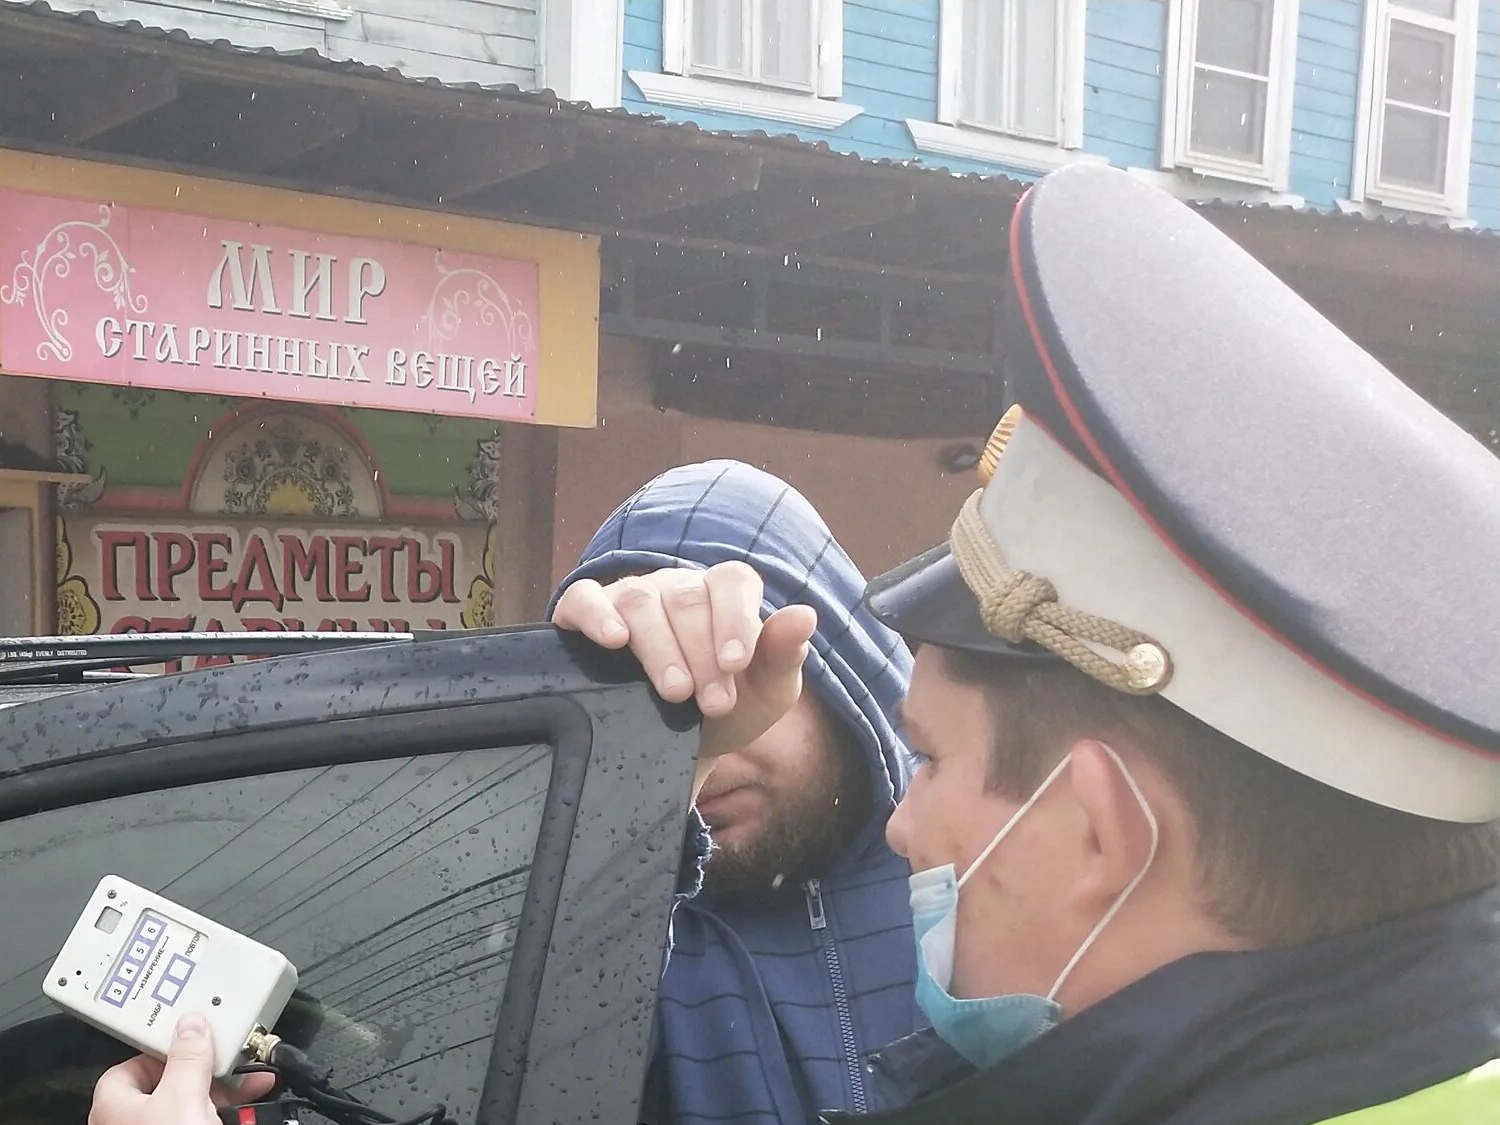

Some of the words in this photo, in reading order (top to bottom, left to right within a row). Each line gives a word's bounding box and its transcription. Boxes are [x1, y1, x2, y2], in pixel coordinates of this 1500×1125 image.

[207, 238, 386, 325] МИР
[94, 314, 371, 384] СТАРИННЫХ
[384, 346, 528, 402] ВЕЩЕЙ
[96, 528, 461, 612] ПРЕДМЕТЫ
[113, 988, 122, 996] 3
[125, 967, 133, 975] 4
[140, 948, 165, 989] ИЗМЕРЕНИЕ
[146, 1003, 162, 1027] КАЛИБР
[184, 931, 201, 957] ПОВТОР
